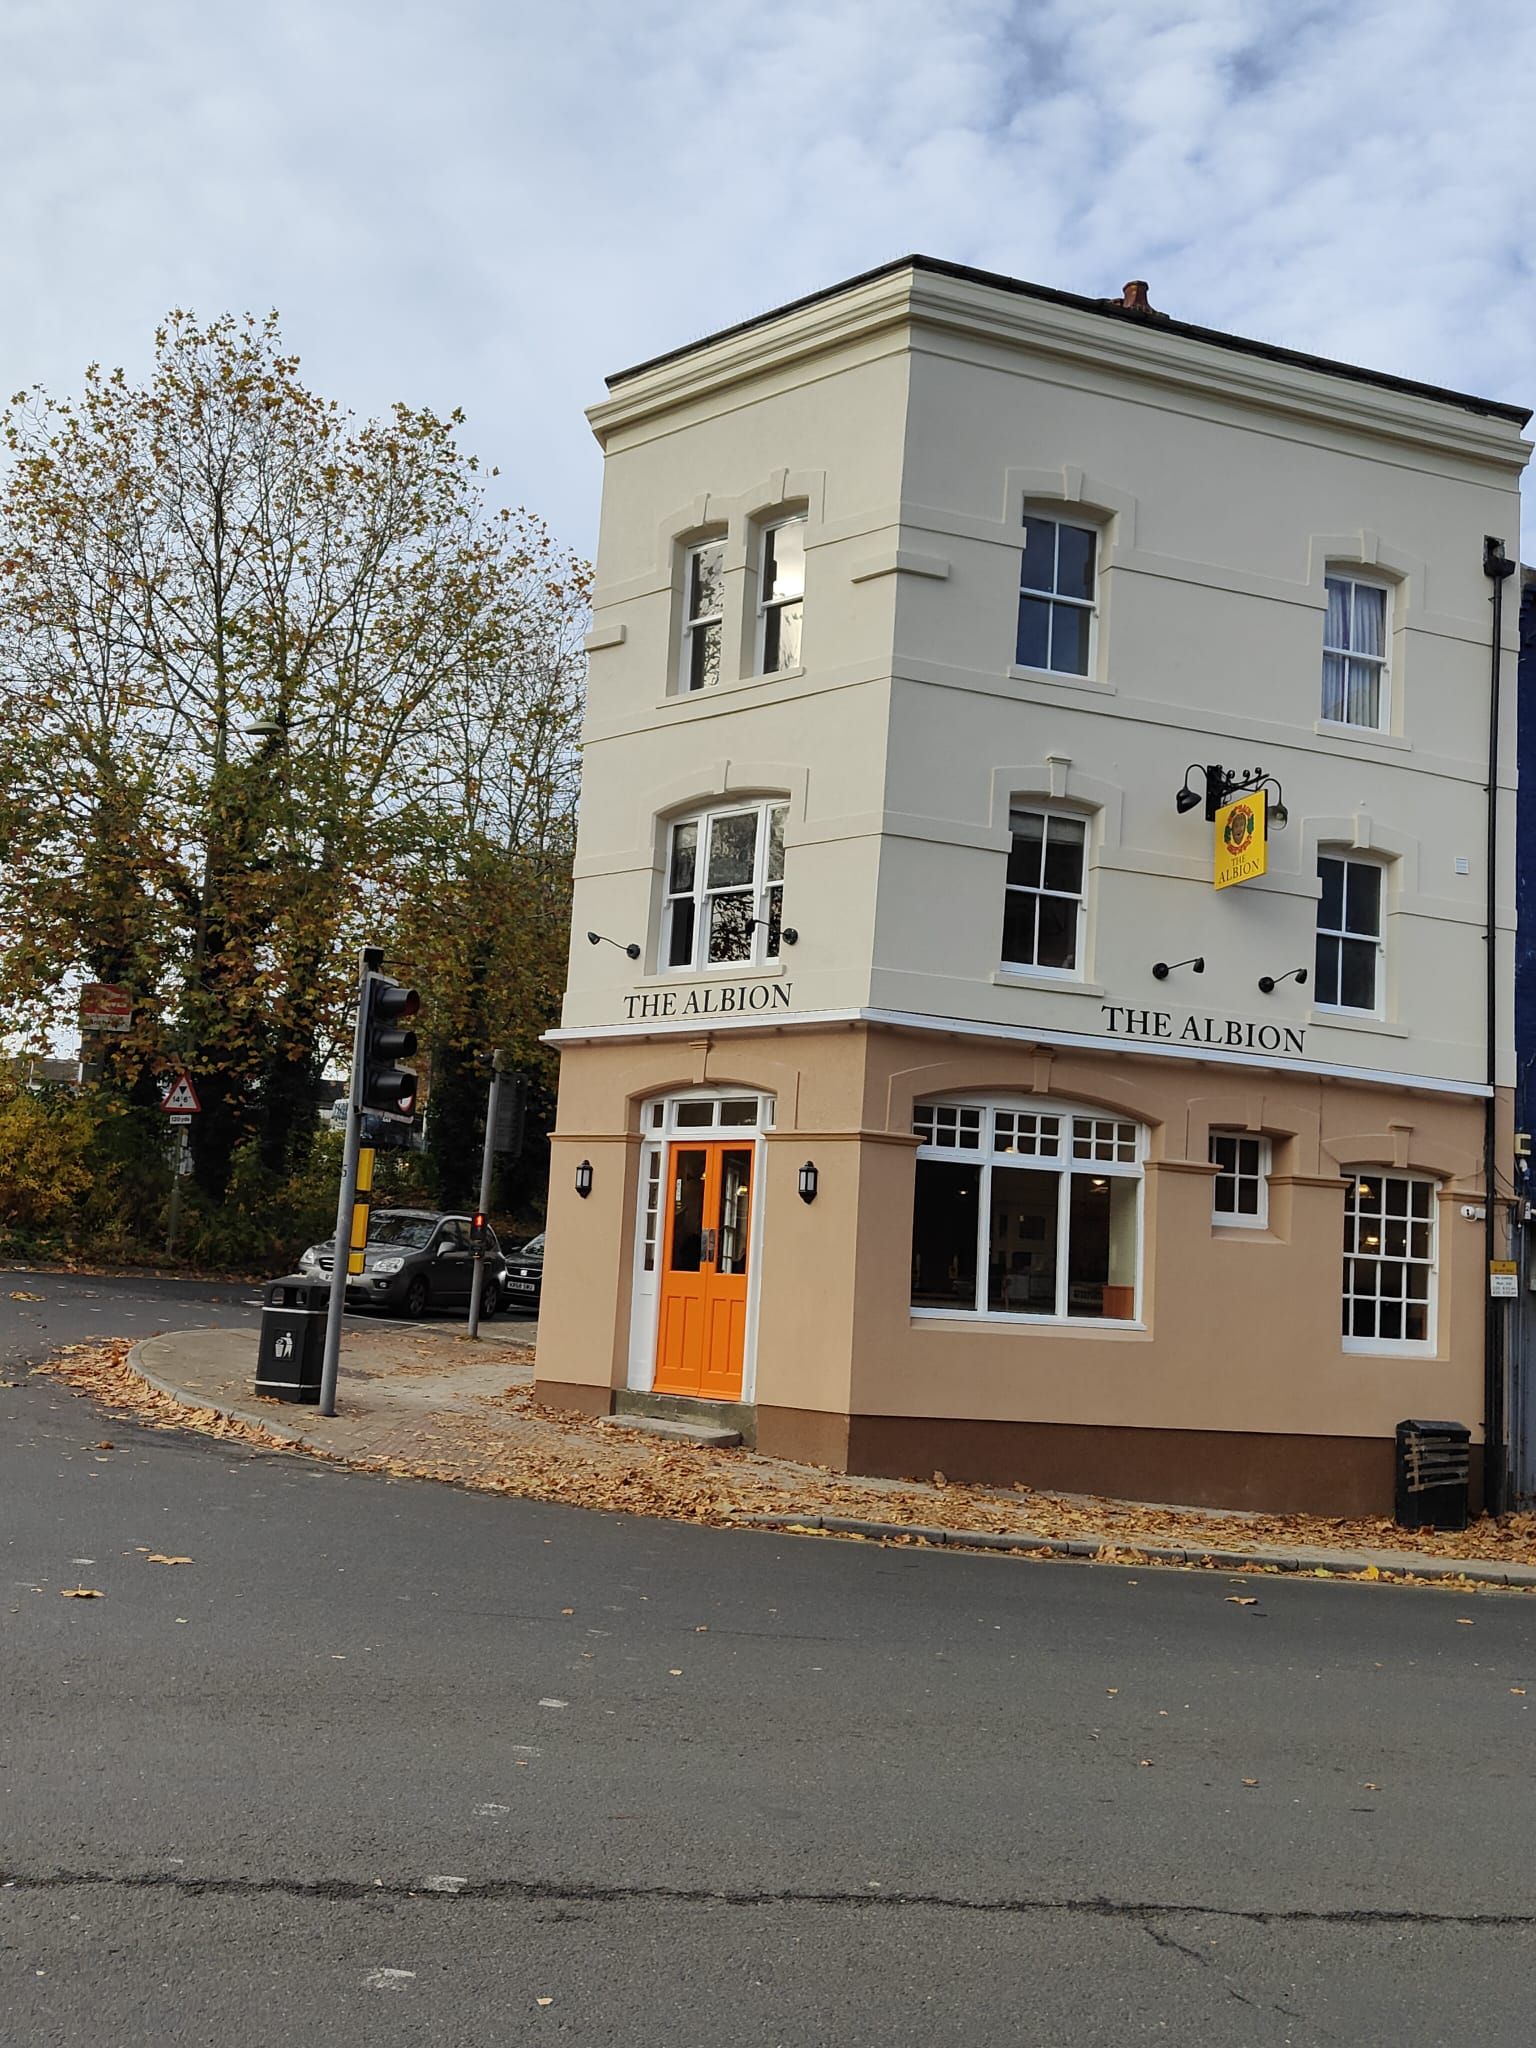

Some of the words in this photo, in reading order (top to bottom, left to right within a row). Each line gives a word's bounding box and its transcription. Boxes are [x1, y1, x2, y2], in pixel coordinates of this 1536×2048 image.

[1218, 858, 1259, 884] ALBION
[1231, 855, 1245, 866] THE
[624, 992, 677, 1019] THE
[682, 983, 793, 1015] ALBION
[1101, 1005, 1173, 1038] THE
[1180, 1015, 1307, 1054] ALBION
